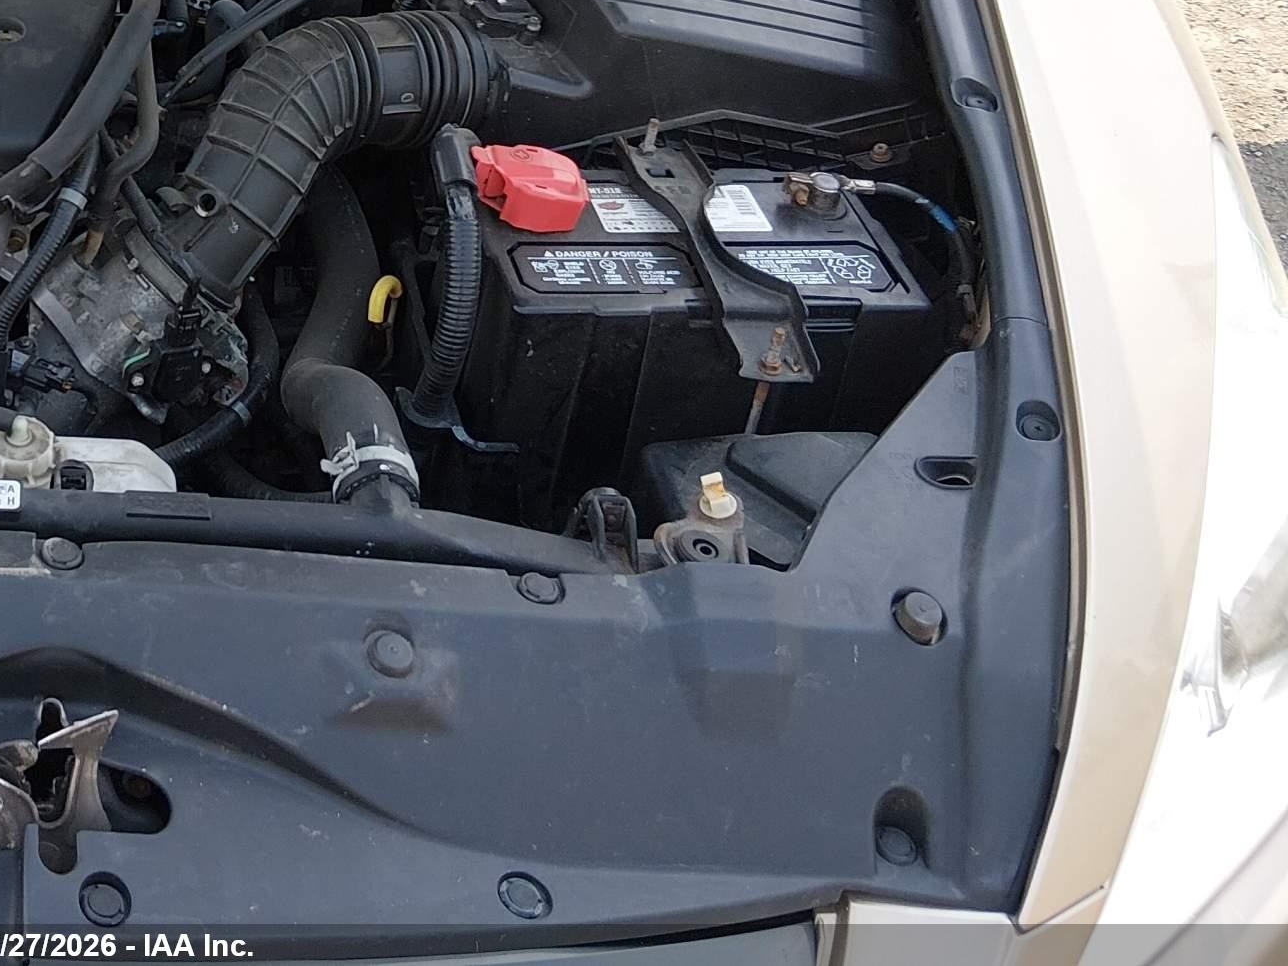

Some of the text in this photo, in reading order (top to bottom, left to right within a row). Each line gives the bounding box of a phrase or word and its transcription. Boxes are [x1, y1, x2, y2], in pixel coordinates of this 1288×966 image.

[555, 250, 601, 258] DANGER
[611, 250, 654, 258] POISON
[7, 485, 15, 493] A
[7, 497, 15, 505] H
